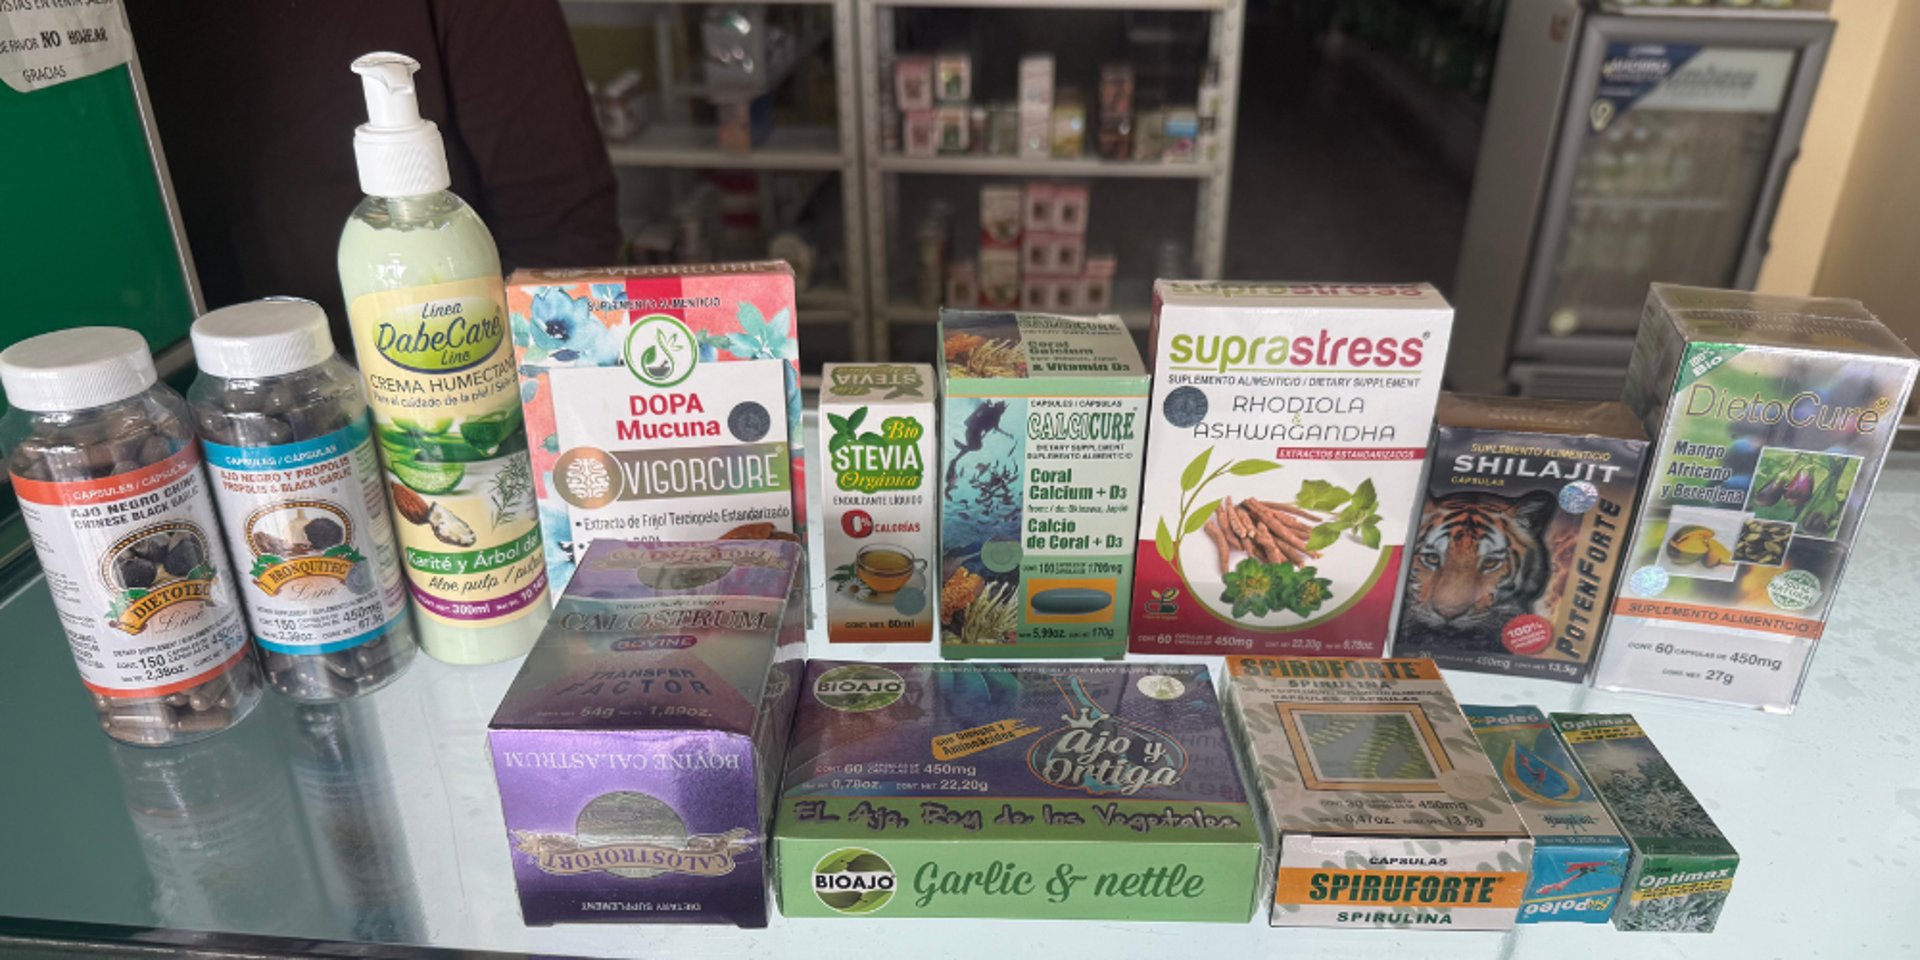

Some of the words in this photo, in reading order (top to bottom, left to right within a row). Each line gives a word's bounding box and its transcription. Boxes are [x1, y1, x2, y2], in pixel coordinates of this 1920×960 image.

[40, 30, 61, 48] NO
[66, 27, 107, 45] HOJEAR
[22, 65, 66, 83] GRACIAS
[588, 300, 656, 312] SUPLEMENTO
[658, 297, 720, 310] ALIMENTICIO
[376, 315, 500, 354] DabeCare
[440, 349, 472, 367] Line
[1169, 328, 1423, 374] suprastress
[1688, 346, 1716, 368] 100%
[1046, 362, 1108, 372] Vitamin
[1691, 354, 1724, 378] Bio
[370, 373, 426, 394] CREMA
[835, 373, 917, 385] STEVIA
[1168, 373, 1237, 386] SUPLEMENTO
[1237, 375, 1301, 387] ALIMENTICIO
[1308, 377, 1350, 388] DIETARY
[1351, 377, 1421, 389] SUPPLEMENT
[402, 395, 441, 408] cuidado
[444, 394, 458, 406] de
[471, 384, 489, 401] piel
[629, 393, 705, 417] DOPA
[1030, 399, 1074, 408] CAPSULES
[1231, 394, 1366, 414] RHODIOLA
[1685, 383, 1880, 435] DietoCure
[617, 418, 721, 441] Mucuna
[889, 419, 919, 440] Bio
[1027, 411, 1136, 442] CALCICURE
[1193, 422, 1396, 443] ASHWAGANDHA
[1036, 443, 1069, 452] DIETARY
[1070, 443, 1125, 452] SUPPLEMENT
[1279, 449, 1333, 458] EXTRACTOS
[1335, 450, 1415, 460] ESTANDARIZADOS
[1471, 443, 1542, 457] SUPLEMENTO
[1543, 447, 1612, 461] ALIMENTICIO
[1672, 439, 1726, 459] Mango
[225, 456, 277, 466] CAPSULES
[835, 444, 919, 471] STEVIA
[220, 470, 239, 481] AJO
[240, 472, 281, 483] NEGRO
[284, 471, 293, 481] Y
[623, 452, 780, 496] VIGORCURE
[1030, 467, 1072, 483] Coral
[1452, 454, 1622, 484] SHILAJIT
[1666, 461, 1732, 481] Africano
[280, 479, 316, 493] BLACK
[318, 467, 352, 485] GARLIC
[840, 471, 920, 491] Orgánica
[73, 486, 134, 501] CAPSULES
[833, 495, 887, 506] ENDULZANTE
[1029, 485, 1094, 500] Calcium
[1096, 487, 1107, 497] +
[1109, 484, 1128, 500] D3
[1661, 484, 1671, 498] y
[1673, 482, 1744, 504] Berenjena
[71, 506, 102, 519] AJO
[106, 492, 160, 515] NEGRO
[74, 514, 129, 530] CHINESE
[132, 502, 169, 521] BLACK
[584, 513, 626, 532] Extracto
[627, 512, 641, 528] de
[642, 510, 668, 532] Frijol
[669, 507, 720, 528] Terciopelo
[721, 503, 790, 522] Estandarizado
[1027, 518, 1076, 533] Calcio
[875, 520, 921, 534] CALORÍAS
[1026, 535, 1046, 550] de
[1048, 534, 1089, 550] Coral
[1092, 537, 1103, 547] +
[1105, 534, 1123, 549] D3
[407, 551, 453, 569] Karité
[457, 560, 468, 575] y
[473, 543, 520, 569] Árbol
[268, 560, 349, 583] BRONQUITEC
[1555, 498, 1622, 660] POTENFORTE
[428, 576, 460, 593] Aloe
[1768, 581, 1815, 605] NATURAL
[131, 583, 211, 619] DIETOTEC
[451, 603, 491, 616] 300ml
[343, 602, 383, 622] 450mg
[1627, 601, 1719, 621] SUPLEMENTO
[1721, 612, 1810, 634] ALIMENTICIO
[560, 610, 769, 634] CALOSTRUM
[887, 618, 915, 630] 60ml
[1506, 620, 1543, 639] 100%
[1092, 627, 1115, 640] 170g
[1157, 634, 1173, 645] 60
[1214, 635, 1254, 649] 450mg
[615, 637, 694, 650] BOVINE
[139, 654, 166, 669] 150
[1475, 654, 1511, 670] 450mg
[1655, 642, 1675, 656] 60
[1729, 651, 1783, 672] 450mg
[588, 667, 696, 681] TRANSFER
[1240, 657, 1420, 680] SPIRUFORTE
[1704, 669, 1735, 686] 27g
[557, 679, 711, 697] FACTOR
[817, 681, 901, 693] BIOAJO
[1287, 680, 1393, 689] SPIRULINA
[580, 706, 616, 719] 54g
[1560, 716, 1634, 731] Optimax
[1056, 728, 1131, 765] Ajo
[1144, 741, 1167, 764] y
[504, 751, 649, 770] CALASTRUM
[653, 752, 740, 770] BOVINE
[844, 764, 864, 775] 60
[923, 763, 977, 777] 450mg
[831, 779, 883, 791] 0,78oz.
[940, 779, 988, 792] 22,20g
[1042, 757, 1182, 796] Ortiga
[1417, 800, 1469, 812] 450mg
[793, 803, 840, 823] EL
[994, 805, 1034, 825] de
[1042, 803, 1086, 825] los
[1092, 804, 1240, 833] Vegetales
[815, 874, 894, 891] BIOAJO
[913, 861, 1035, 908] Garlic
[1046, 863, 1087, 903] &
[1095, 863, 1206, 899] nettle
[1309, 872, 1497, 904] SPIRUFORTE
[1639, 868, 1730, 889] Optimax
[580, 901, 655, 912] SUPPLEMENT
[655, 902, 702, 912] DIETARY
[1336, 910, 1453, 926] SPIRULINA
